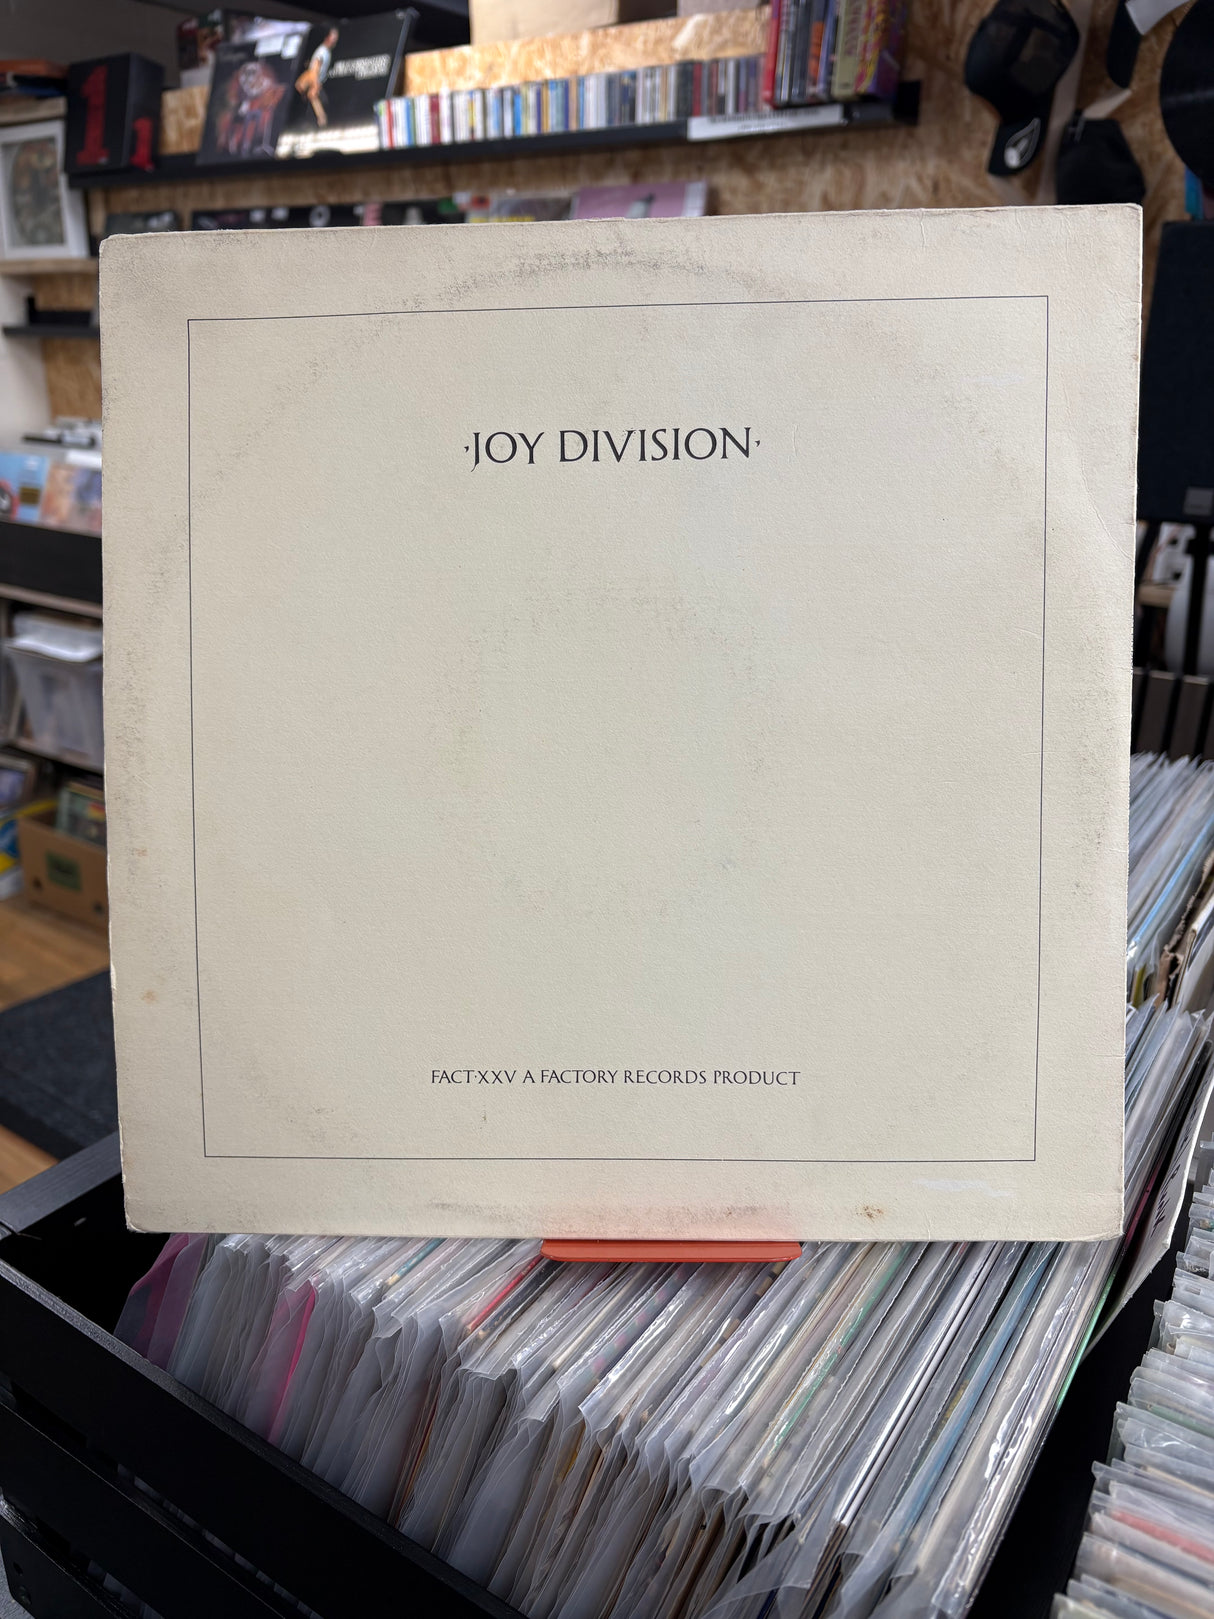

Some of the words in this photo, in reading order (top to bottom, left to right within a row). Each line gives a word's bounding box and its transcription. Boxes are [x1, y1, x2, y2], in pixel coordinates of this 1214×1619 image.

[522, 1069, 536, 1084] A
[540, 1069, 618, 1085] FACTORY
[623, 1069, 707, 1085] RECORDS
[713, 1070, 801, 1086] PRODUCT
